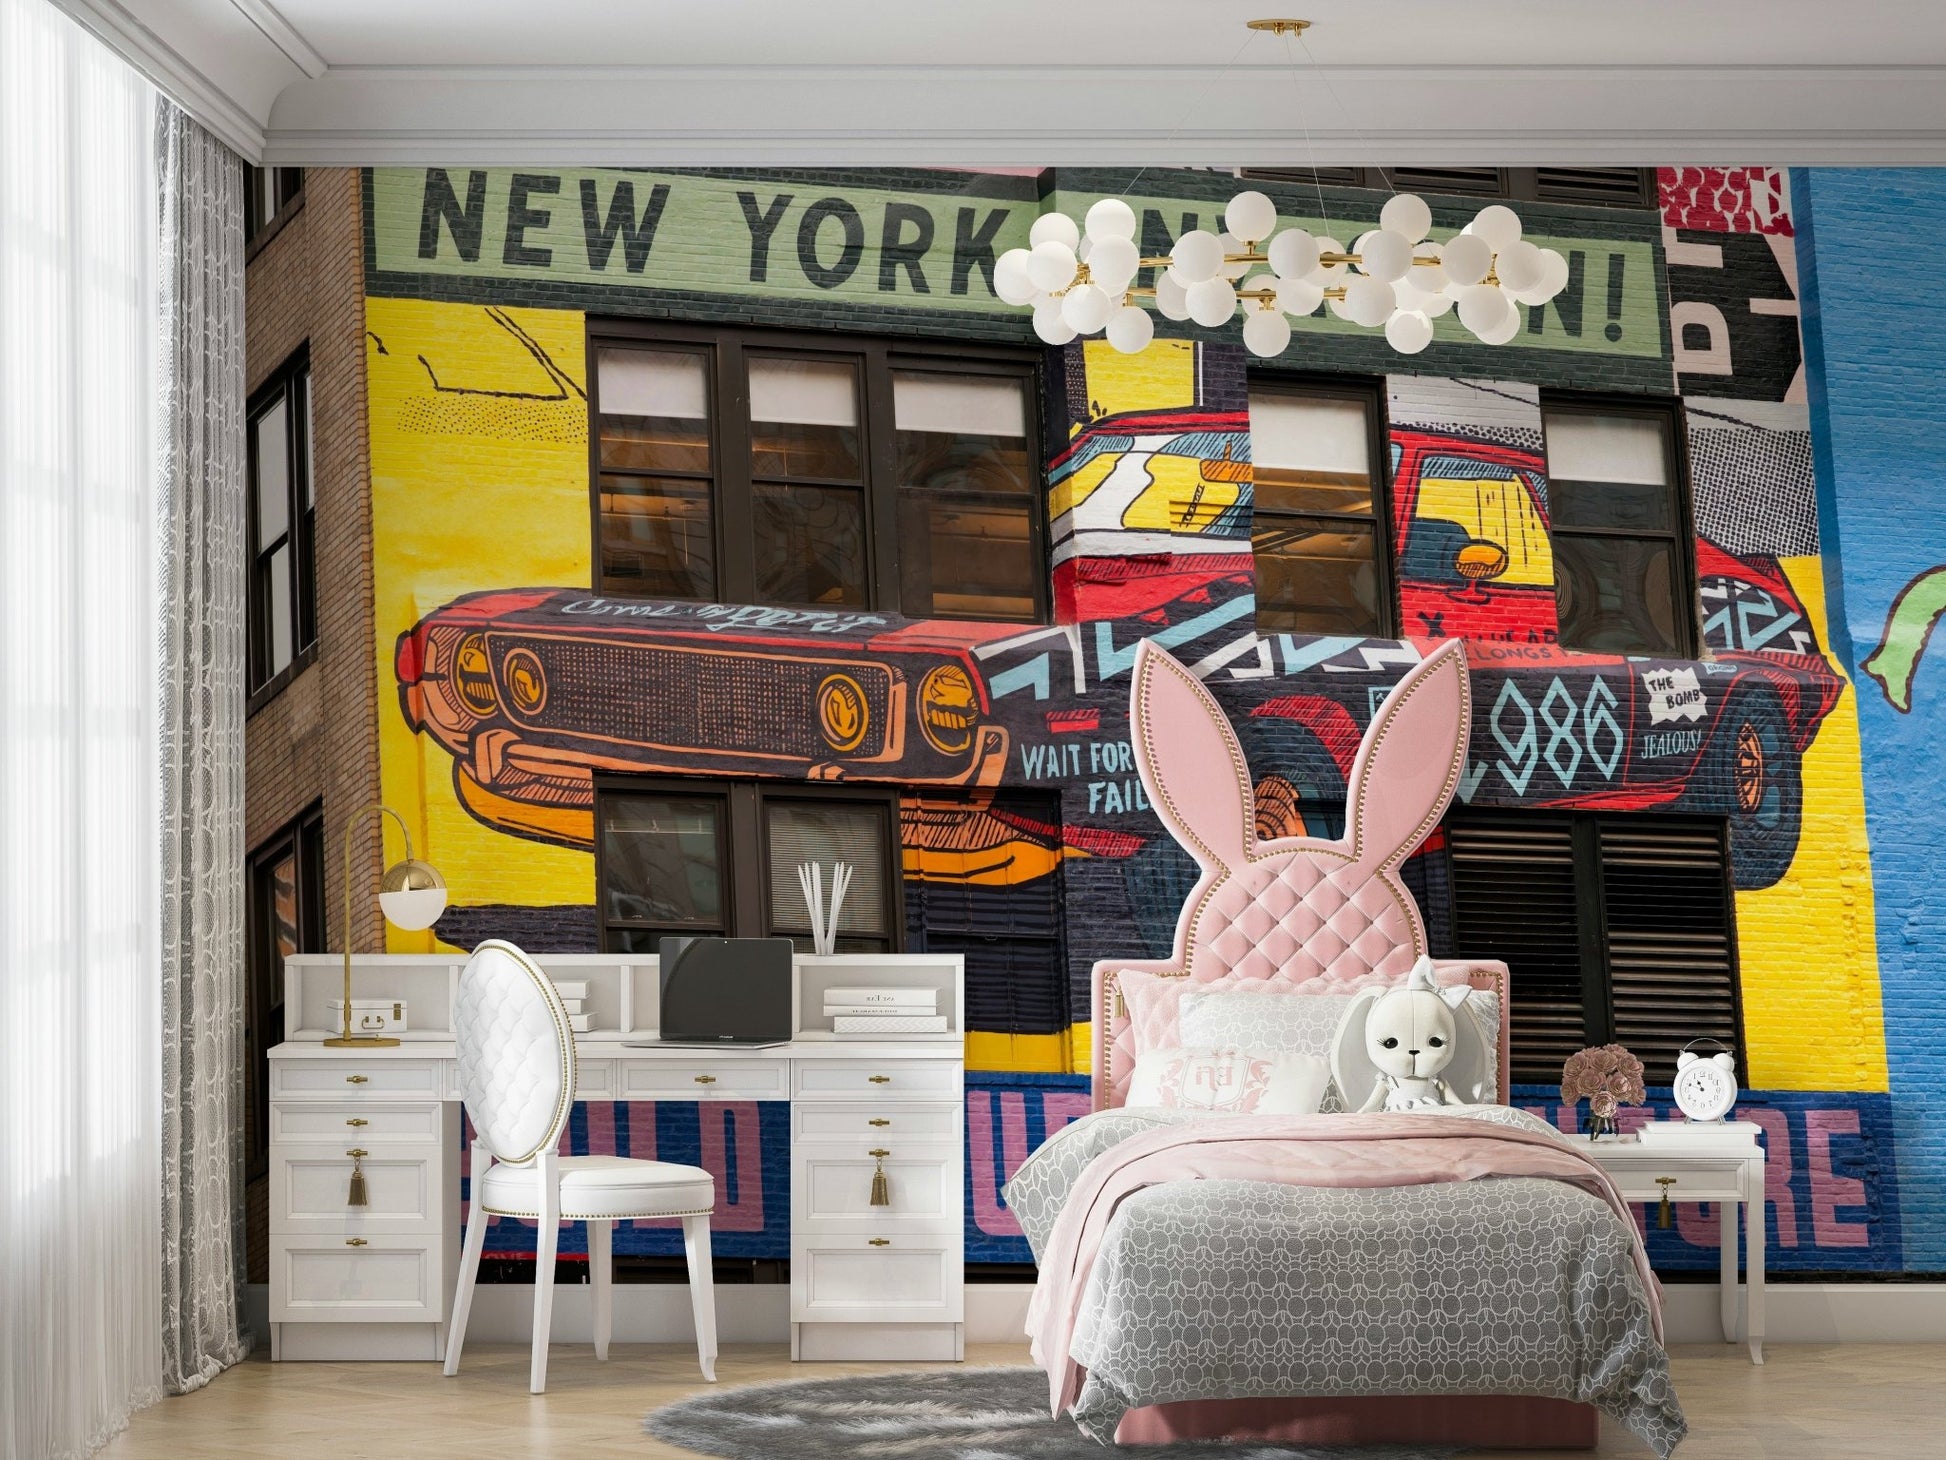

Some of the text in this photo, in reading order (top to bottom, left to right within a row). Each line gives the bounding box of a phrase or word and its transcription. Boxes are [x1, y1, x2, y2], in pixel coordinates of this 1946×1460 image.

[418, 168, 671, 273] NEW
[736, 191, 1011, 298] YORK
[1649, 676, 1674, 691] THE
[1666, 689, 1700, 709] BOMB
[1021, 741, 1133, 780] WAIT FOR
[1088, 779, 1152, 814] FAIL
